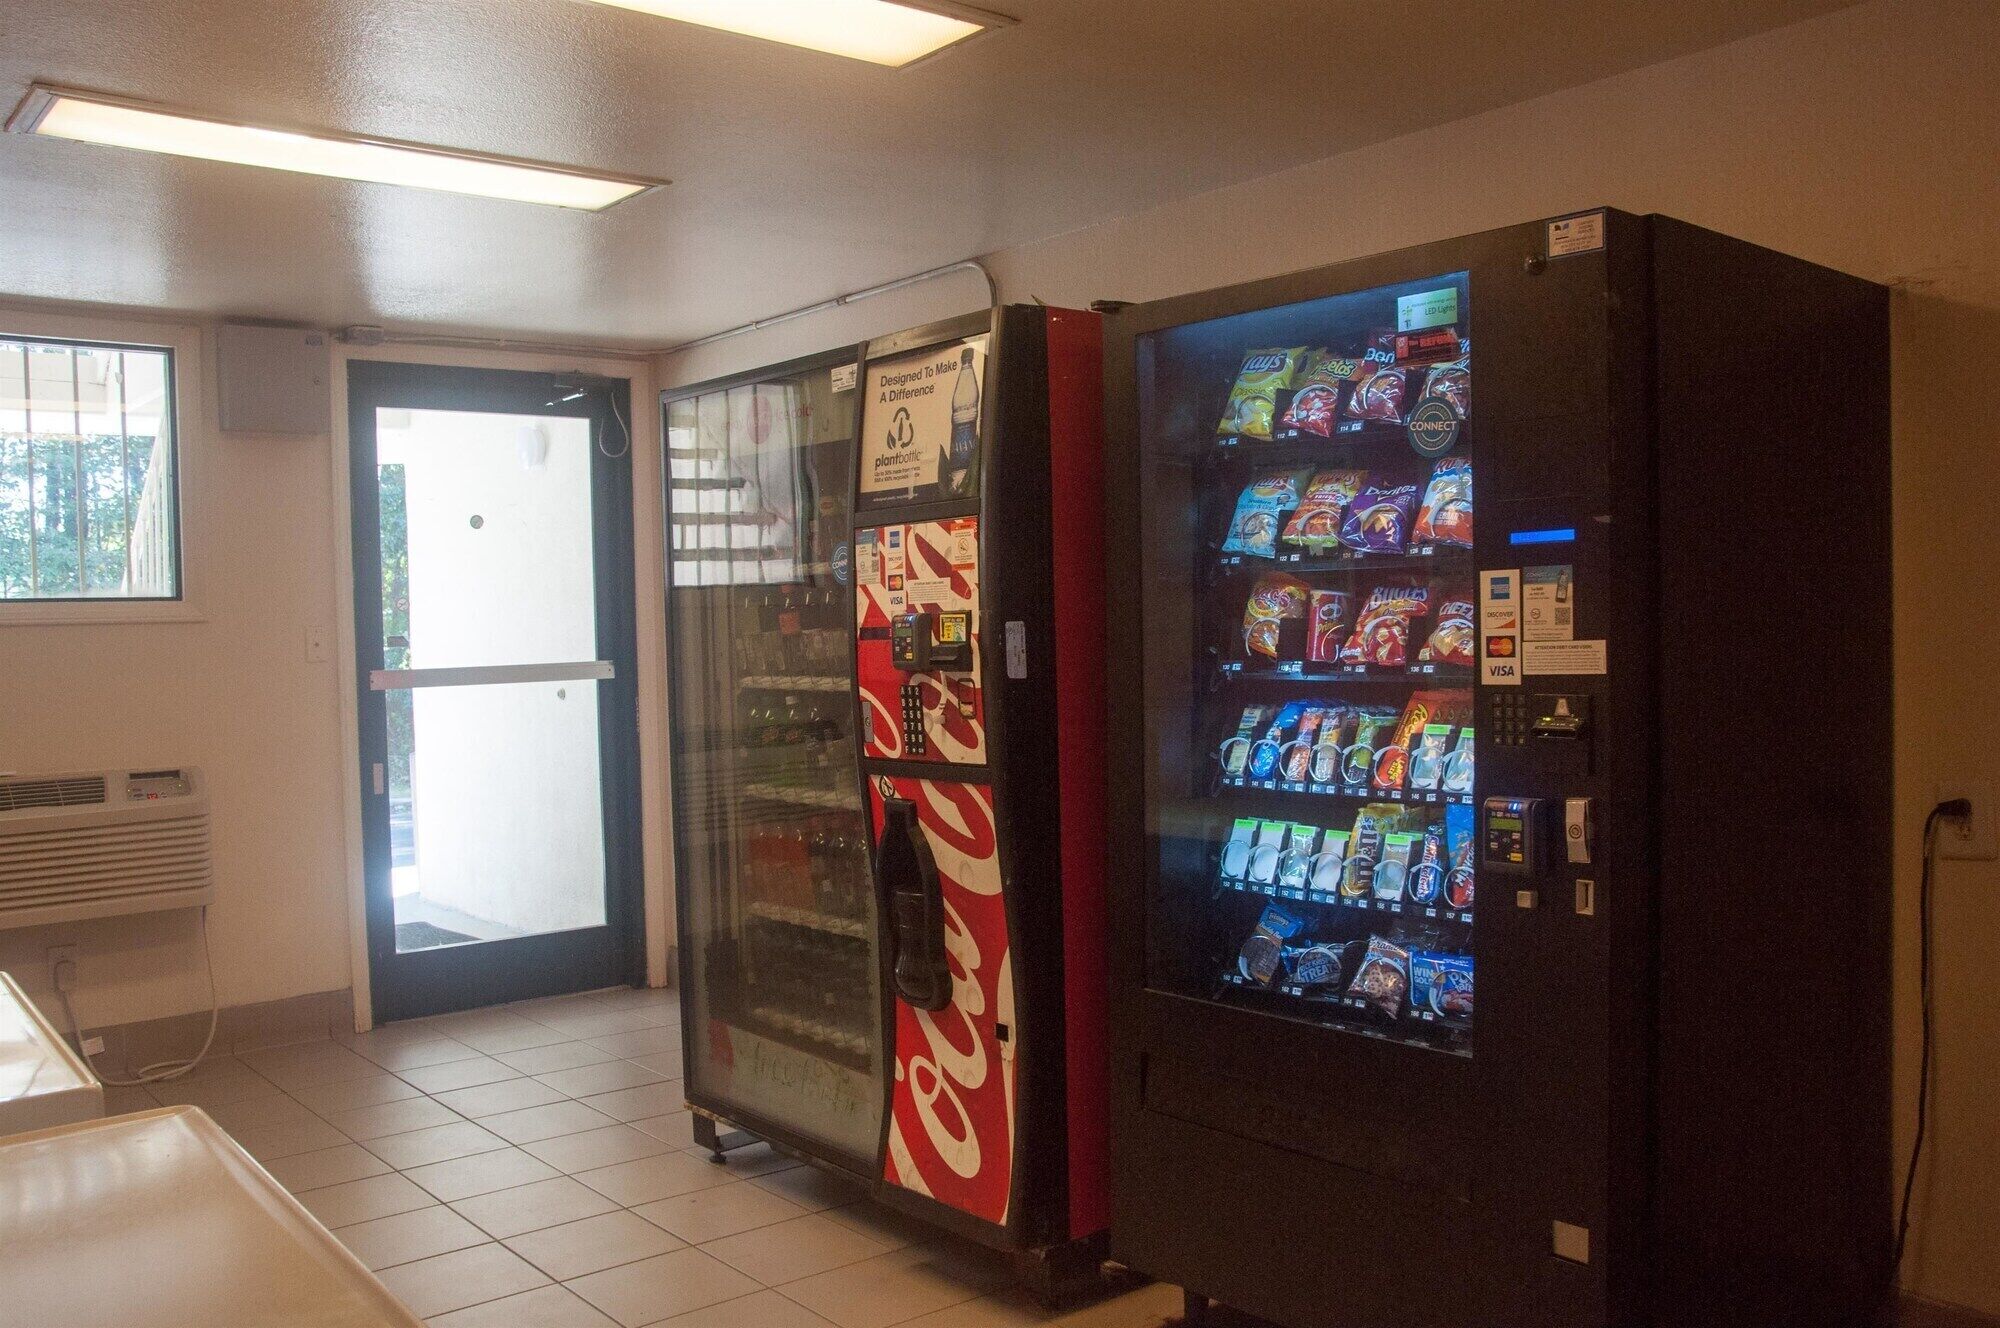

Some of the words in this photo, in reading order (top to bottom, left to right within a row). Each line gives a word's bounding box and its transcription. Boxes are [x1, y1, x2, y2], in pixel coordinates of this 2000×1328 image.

[1425, 307, 1437, 315] LED
[880, 371, 923, 387] Designed
[925, 365, 933, 378] To
[935, 360, 958, 375] Make
[880, 391, 887, 403] A
[889, 385, 935, 401] Difference
[1409, 420, 1457, 432] CONNECT
[1364, 485, 1417, 496] Doritos
[1373, 586, 1428, 603] BUGLES
[890, 596, 904, 606] VISA
[1490, 665, 1515, 677] VISA
[1413, 966, 1433, 978] WIN
